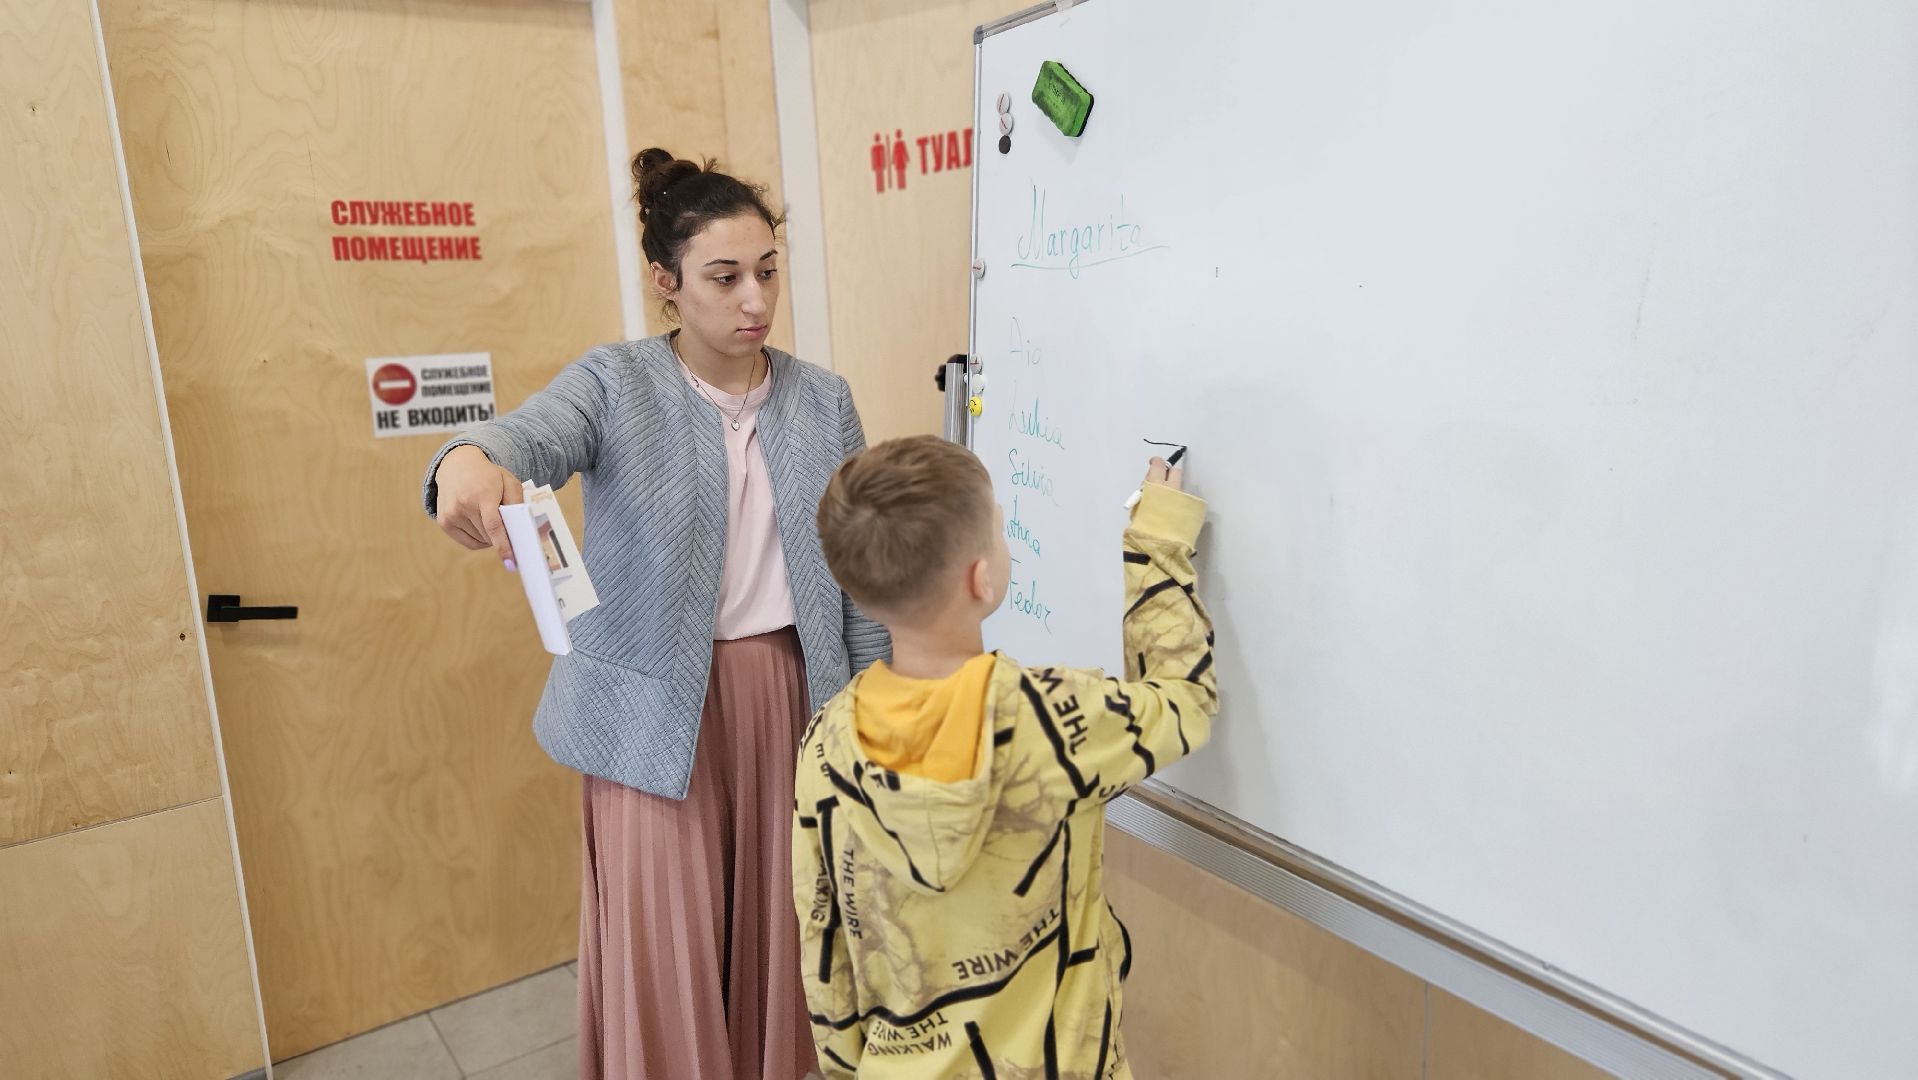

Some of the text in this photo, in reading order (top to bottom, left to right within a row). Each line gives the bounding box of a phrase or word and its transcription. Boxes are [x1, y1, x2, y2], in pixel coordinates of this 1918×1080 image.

[916, 128, 974, 176] ТУАЛ
[331, 200, 476, 226] СЛУЖЕБНОЕ
[332, 236, 482, 264] ПОМЕЩЕНИЕ
[421, 365, 488, 381] СЛУЖЕБНОЕ
[421, 382, 491, 397] ПОМЕЩЕНИЕ
[376, 403, 494, 430] НЕ ВХОДИТЬ!
[1053, 694, 1088, 756] THE
[811, 854, 832, 922] ALKING
[843, 848, 863, 940] THE WIRE
[952, 908, 1060, 980] THE WIRE
[910, 1011, 948, 1039] THE
[868, 1031, 953, 1057] WALKING
